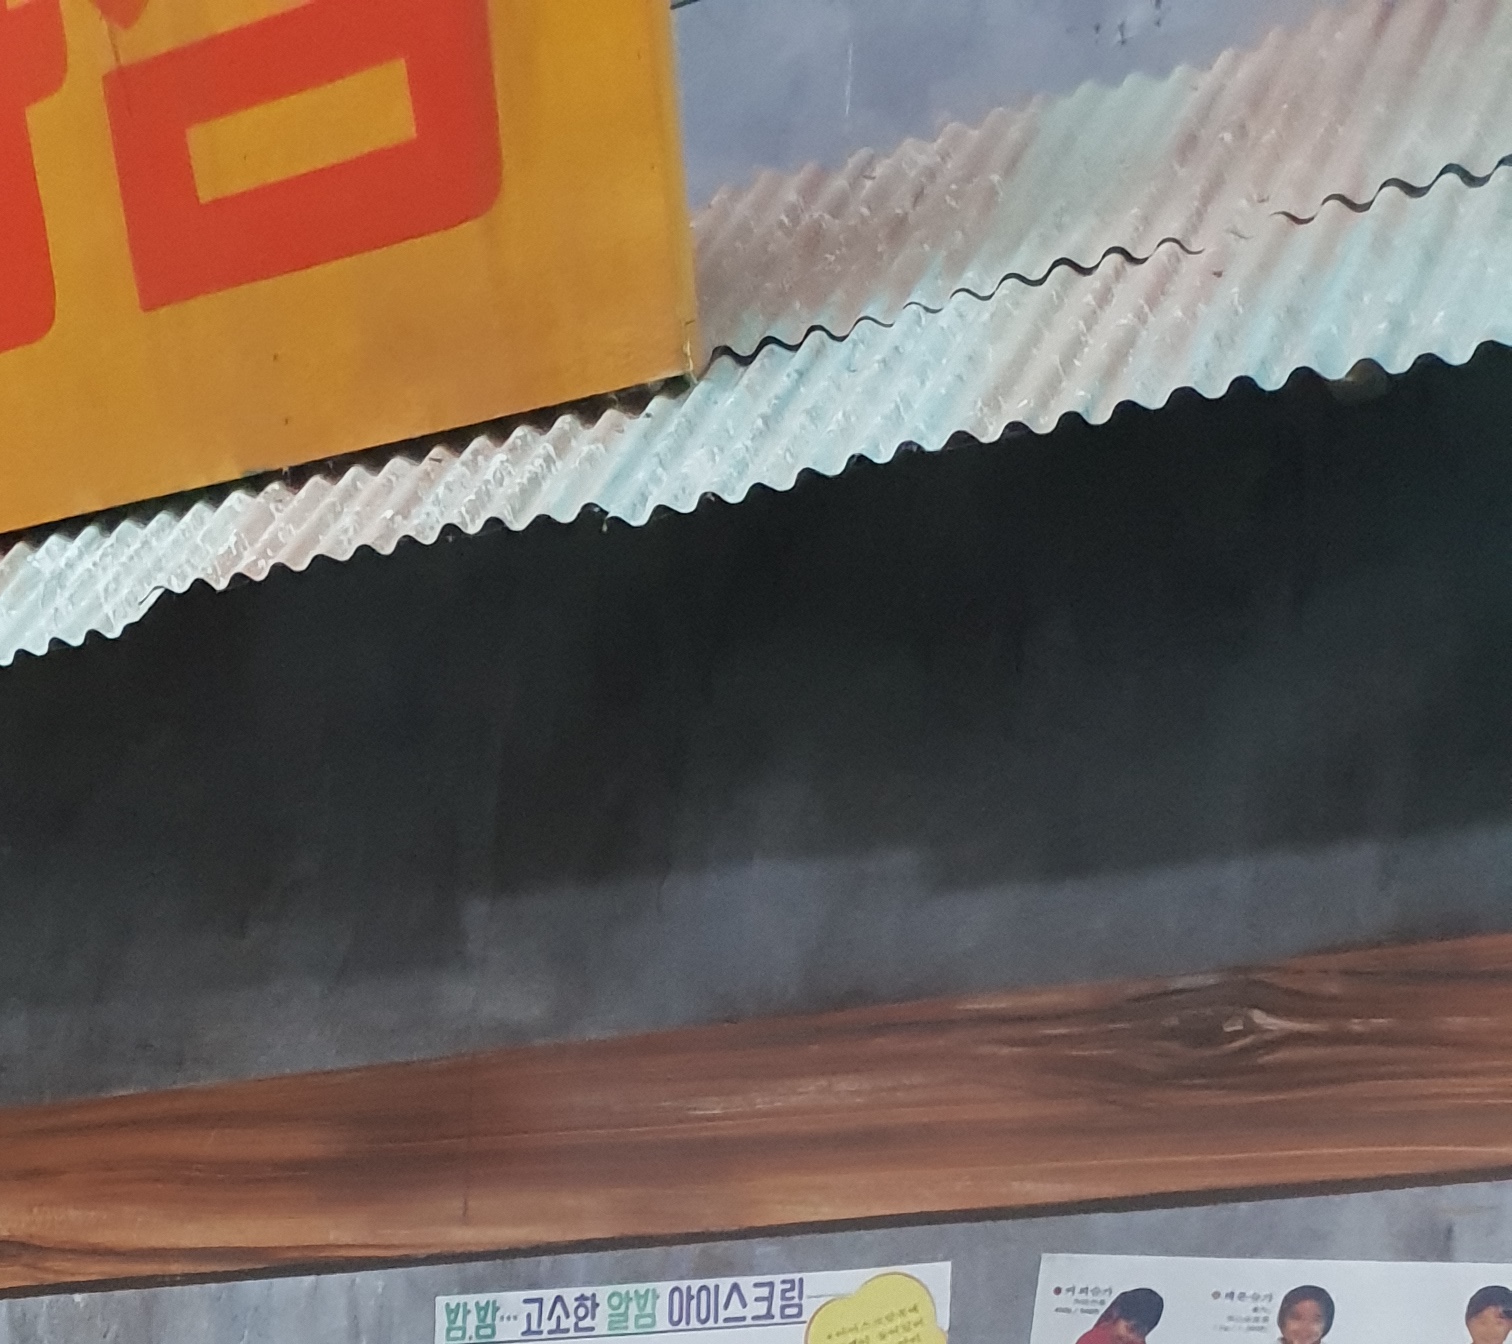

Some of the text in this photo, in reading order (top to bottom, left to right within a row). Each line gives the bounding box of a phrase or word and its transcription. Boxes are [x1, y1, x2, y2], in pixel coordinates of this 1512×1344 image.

[520, 1291, 600, 1338] 고소한
[606, 1286, 661, 1333] 알밤
[667, 1276, 805, 1328] 아이스크림
